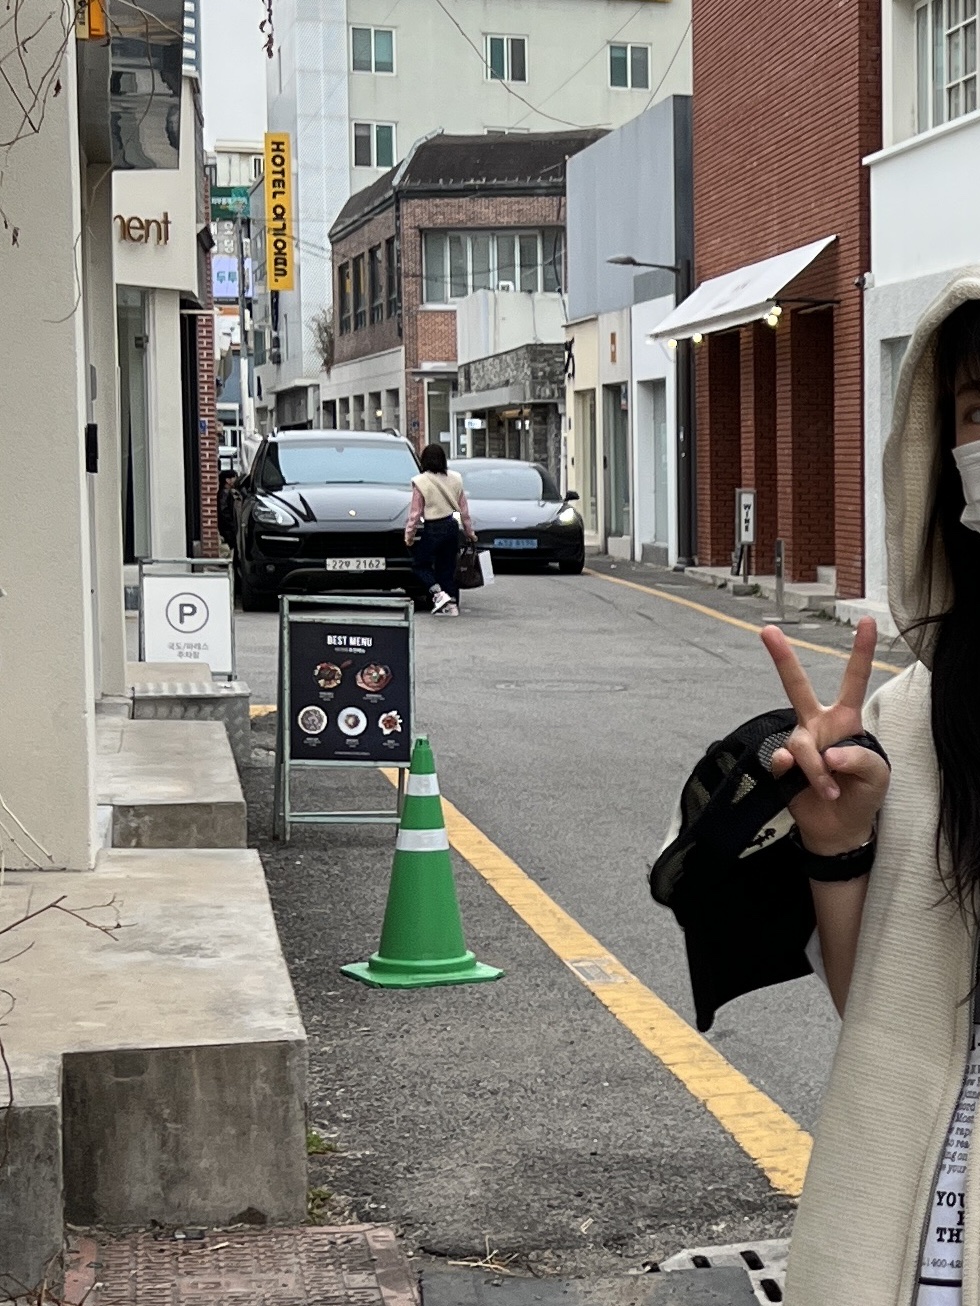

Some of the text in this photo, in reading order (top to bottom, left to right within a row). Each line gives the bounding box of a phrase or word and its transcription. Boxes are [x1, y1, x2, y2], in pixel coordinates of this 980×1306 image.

[271, 141, 285, 199] HOTEL
[179, 603, 197, 624] P
[327, 635, 373, 647] BEST MENU
